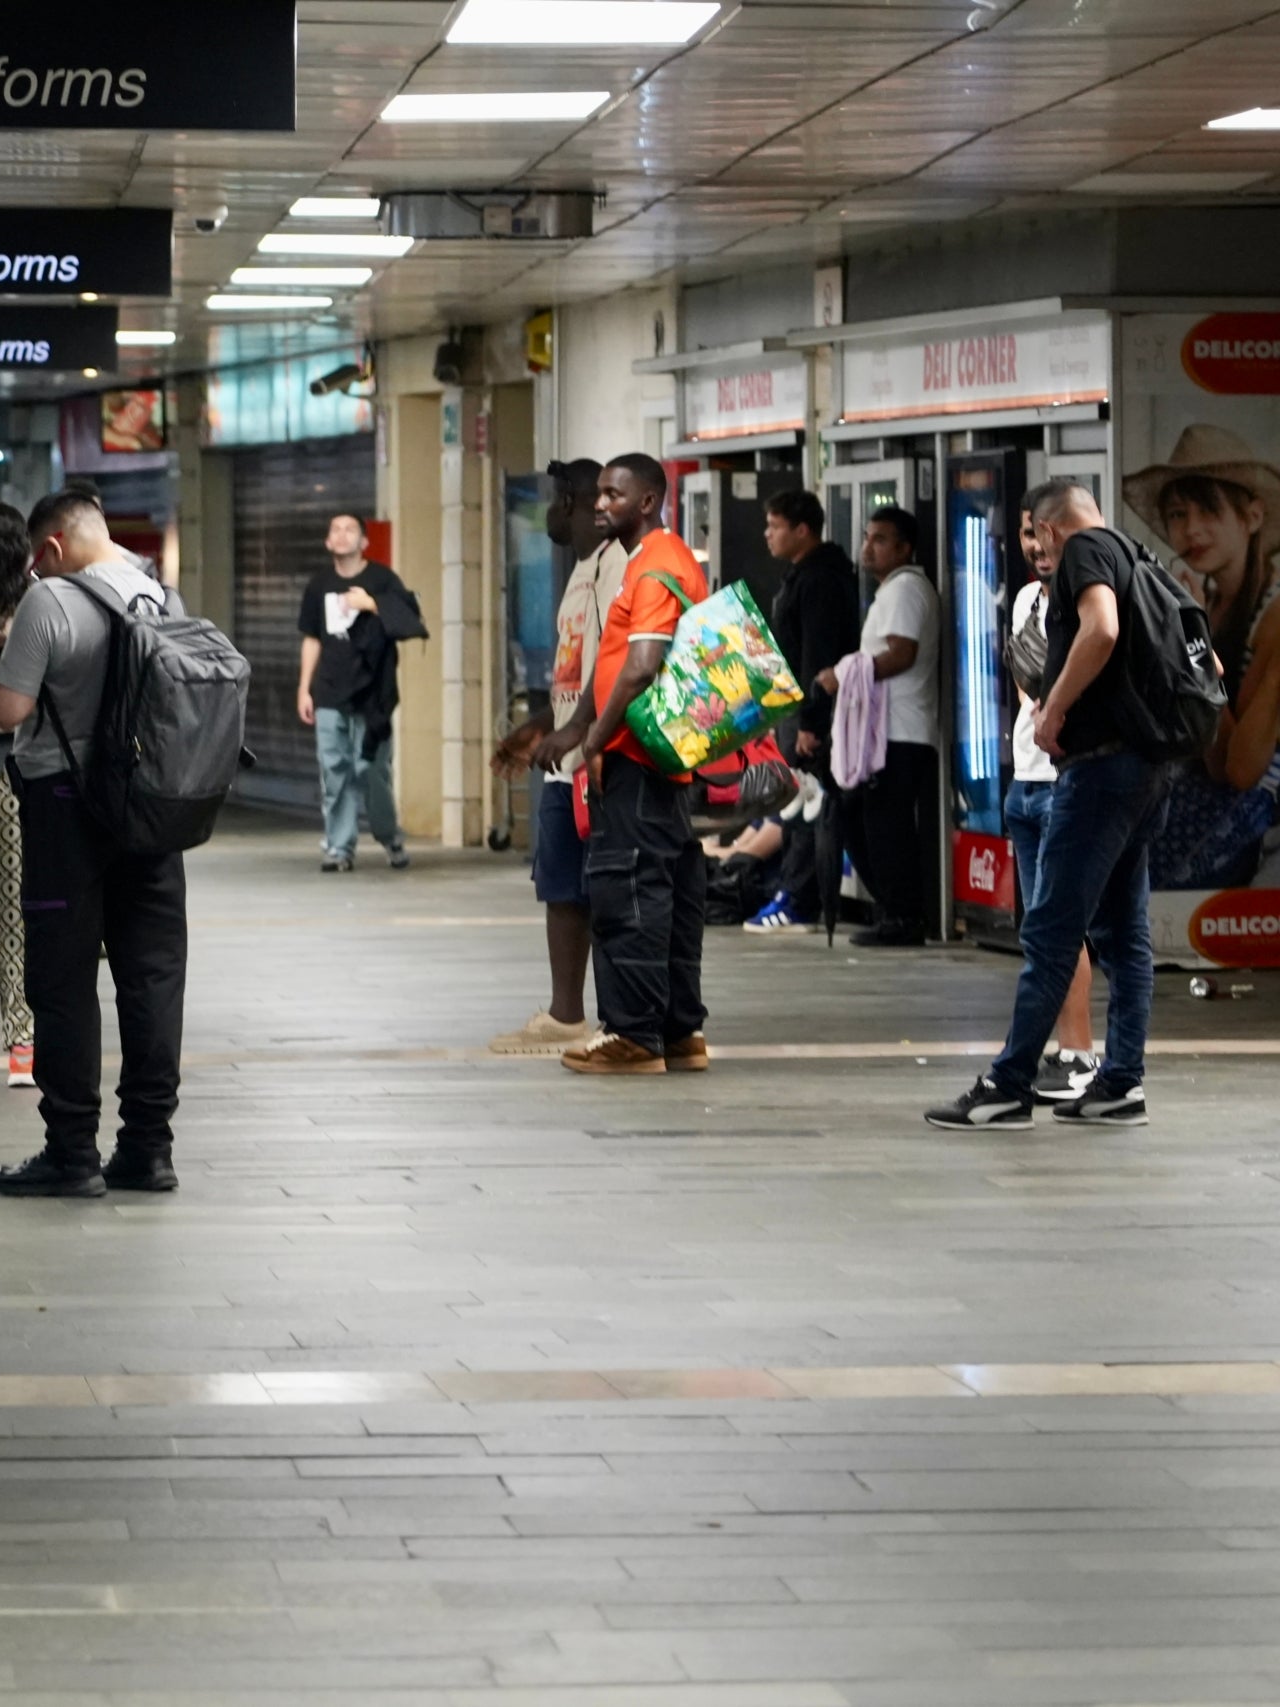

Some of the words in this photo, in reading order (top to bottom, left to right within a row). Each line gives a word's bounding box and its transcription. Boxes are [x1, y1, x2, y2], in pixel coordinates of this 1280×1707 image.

[923, 341, 952, 392] DELI
[957, 333, 1018, 388] CORNER
[1200, 915, 1280, 936] DELICO
